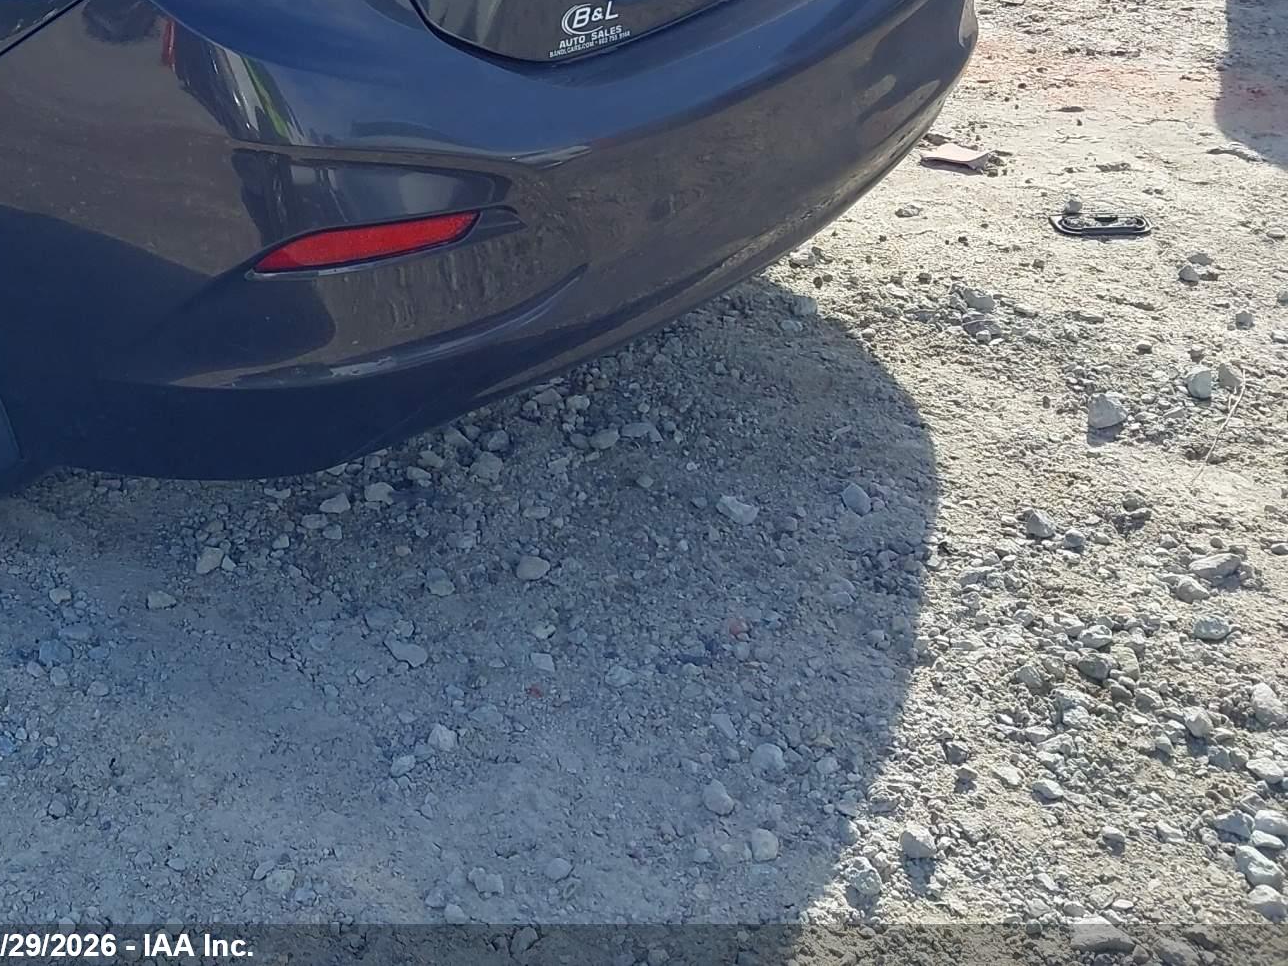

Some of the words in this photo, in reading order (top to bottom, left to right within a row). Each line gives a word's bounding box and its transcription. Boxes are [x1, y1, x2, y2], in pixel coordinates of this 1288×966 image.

[572, 1, 619, 29] B&L
[559, 35, 586, 48] AUTO
[591, 25, 623, 40] SALES
